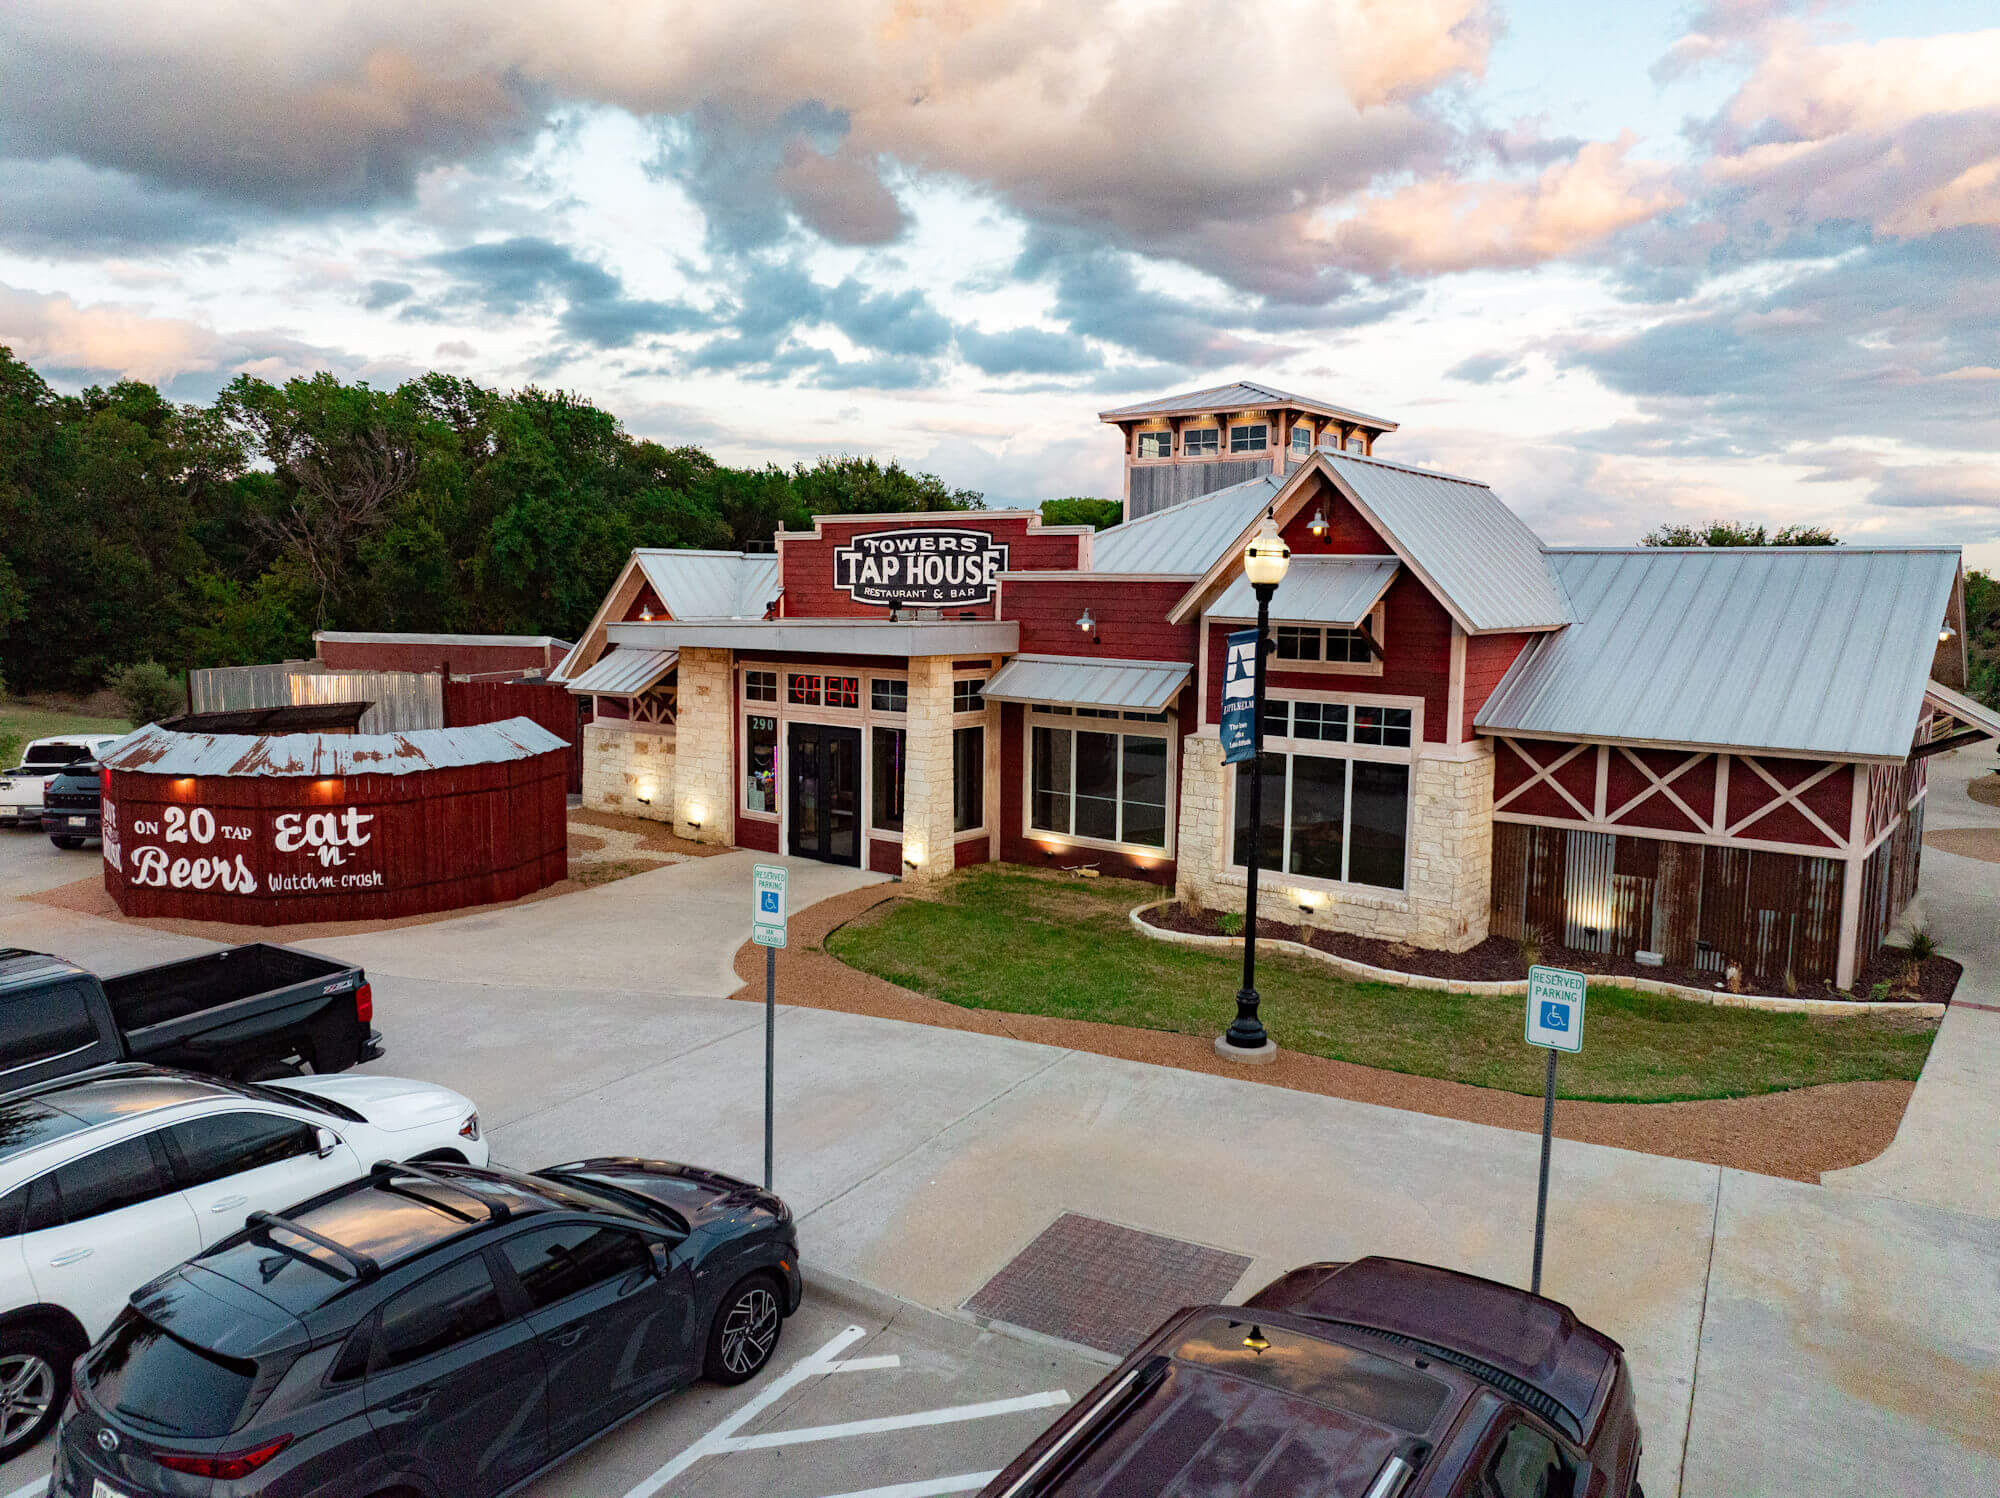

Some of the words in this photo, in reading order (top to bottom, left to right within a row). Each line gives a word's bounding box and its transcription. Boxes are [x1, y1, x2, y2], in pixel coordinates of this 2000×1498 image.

[863, 537, 978, 554] TOWERS
[841, 552, 900, 584] TAP
[906, 551, 1000, 585] HOUSE
[864, 587, 927, 598] RESTAURANT
[933, 589, 944, 599] &
[950, 587, 975, 598] BAR
[795, 675, 856, 704] OPEN
[752, 717, 774, 732] 290
[134, 820, 158, 835] ON
[164, 806, 216, 844] 20
[221, 826, 252, 841] TAP
[274, 807, 374, 852] Eat
[130, 845, 258, 894] Beers
[756, 871, 785, 882] RESERVED
[759, 880, 783, 890] PARKING
[1533, 973, 1582, 989] RESERVED
[1536, 986, 1577, 1002] PARKING
